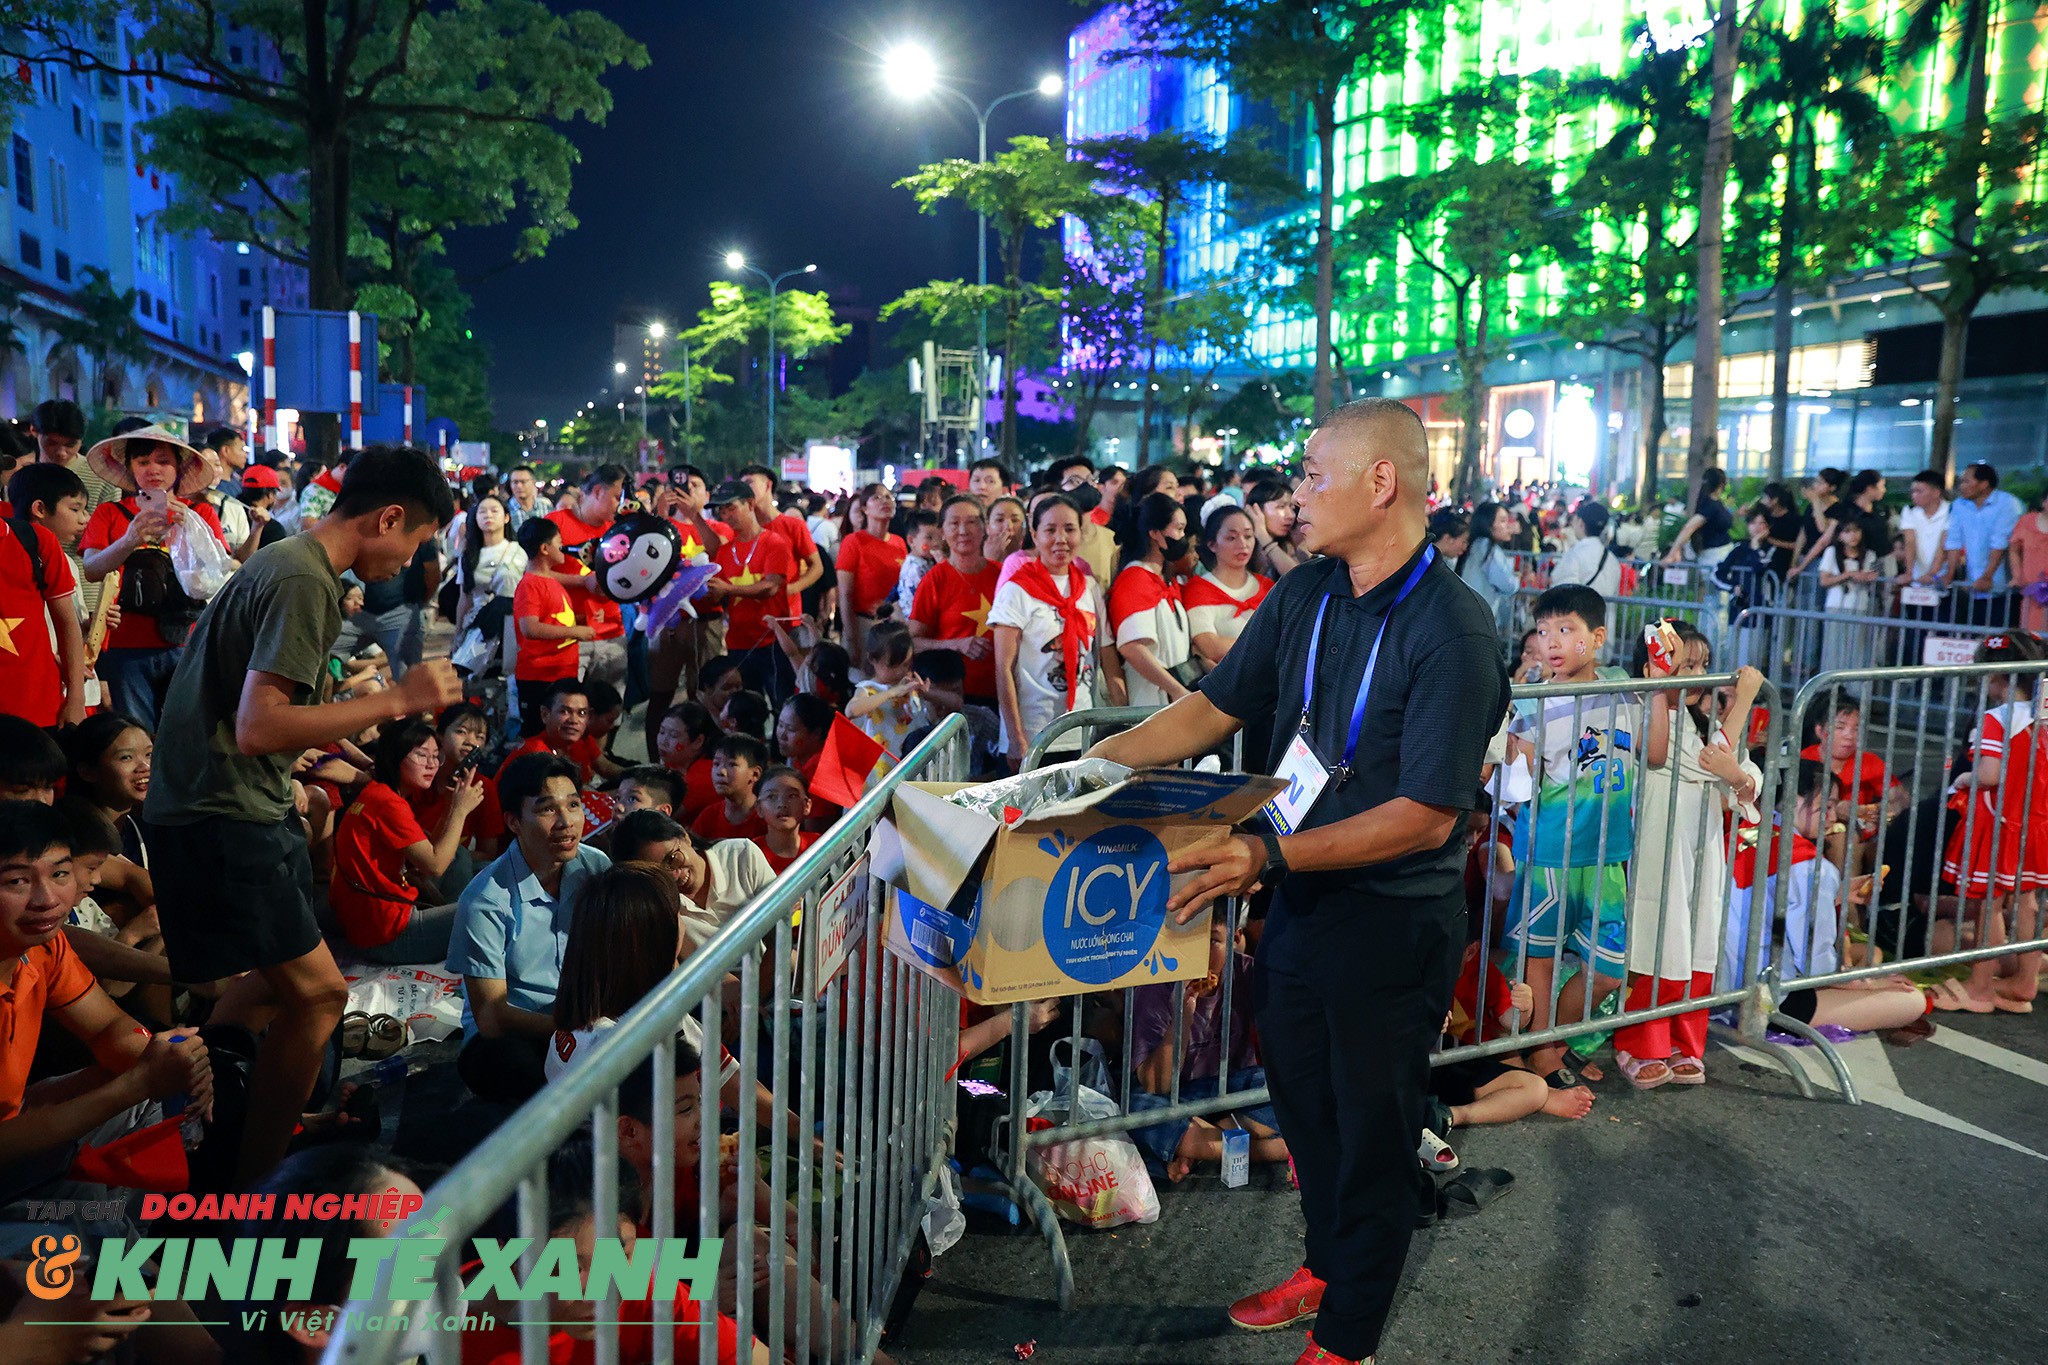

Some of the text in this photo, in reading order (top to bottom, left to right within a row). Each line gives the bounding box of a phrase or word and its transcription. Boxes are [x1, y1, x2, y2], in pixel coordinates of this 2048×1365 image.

[1937, 651, 1974, 663] STOP
[1591, 757, 1625, 794] 23
[1283, 772, 1305, 807] N
[1272, 810, 1289, 834] NINH
[1097, 843, 1138, 854] VINAMILK
[1063, 861, 1160, 928] ICY
[1103, 932, 1120, 944] ÓNG
[1120, 931, 1134, 942] CHAI
[1231, 1162, 1249, 1172] true
[1047, 1170, 1119, 1200] ONLINE
